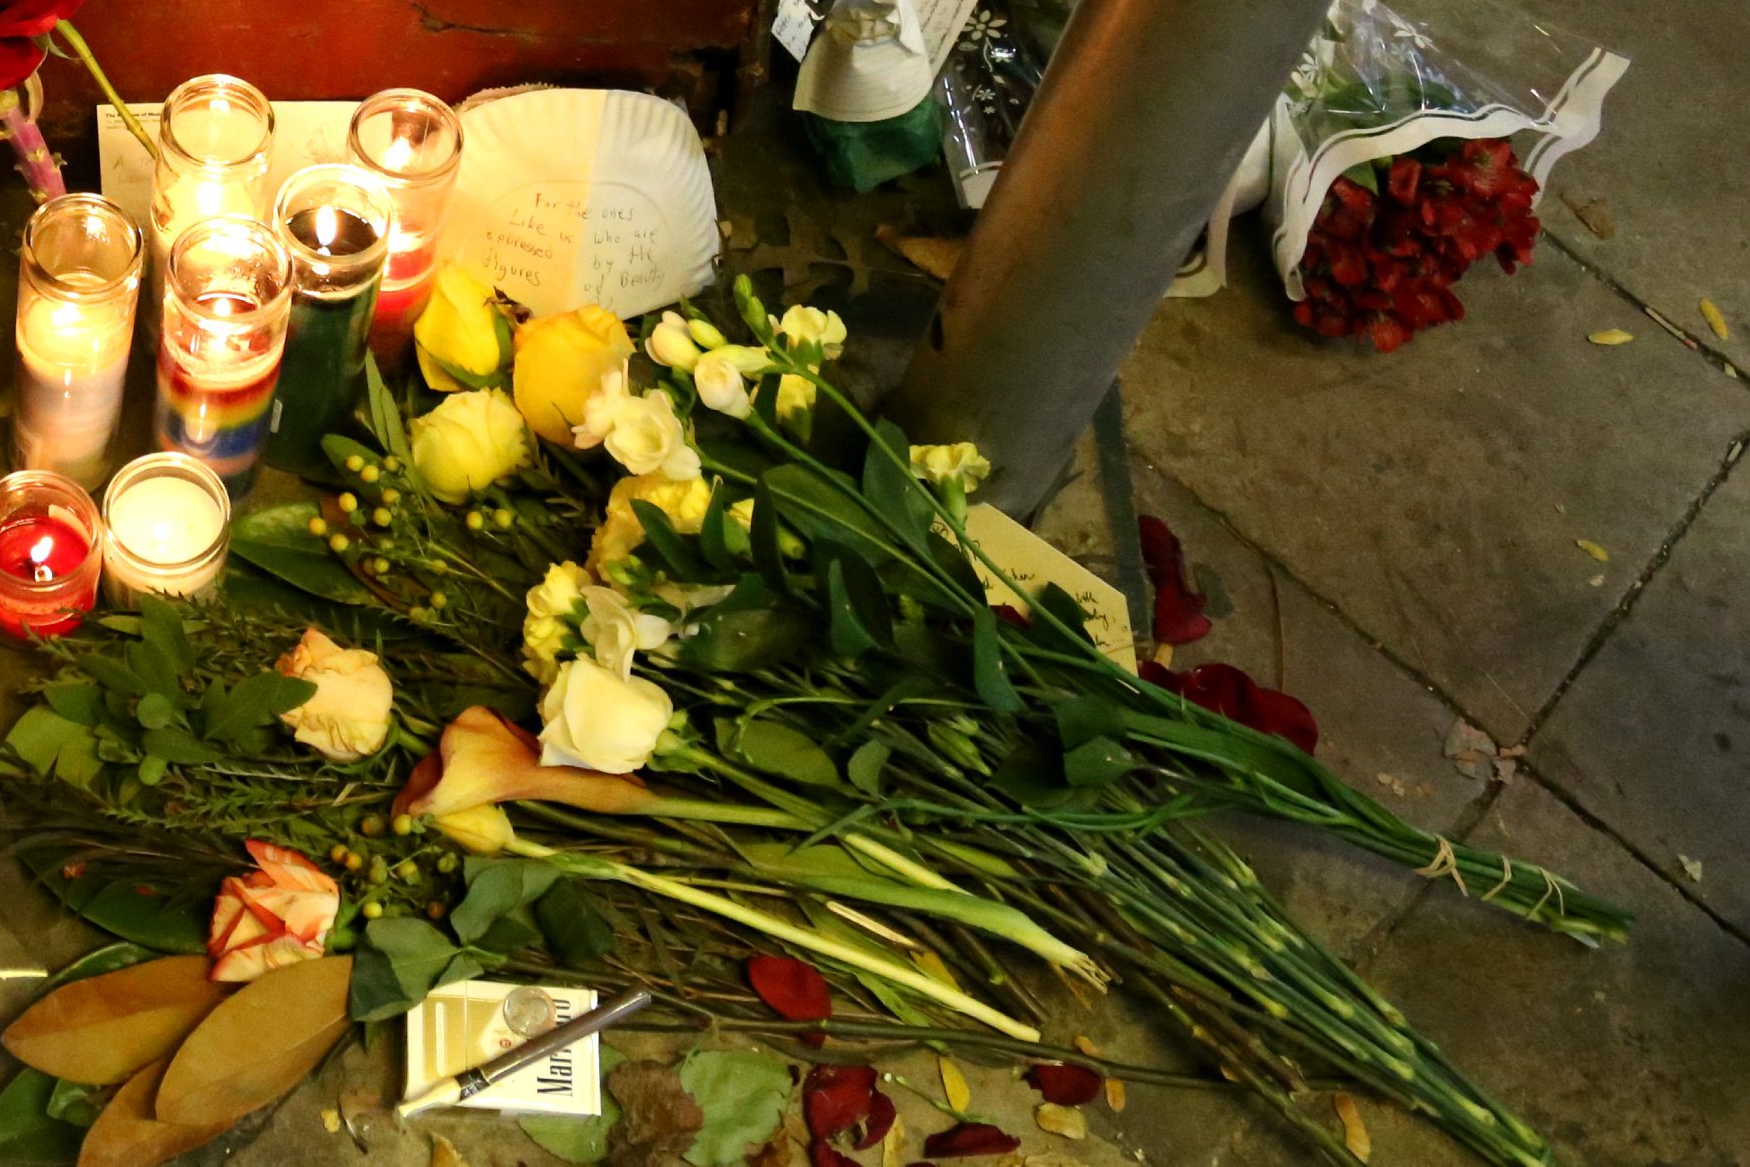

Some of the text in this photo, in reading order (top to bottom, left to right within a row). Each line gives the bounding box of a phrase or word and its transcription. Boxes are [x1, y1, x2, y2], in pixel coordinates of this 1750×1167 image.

[535, 193, 559, 208] For
[601, 207, 634, 221] ones
[633, 227, 658, 245] are
[481, 246, 541, 287] figures
[593, 255, 614, 273] by
